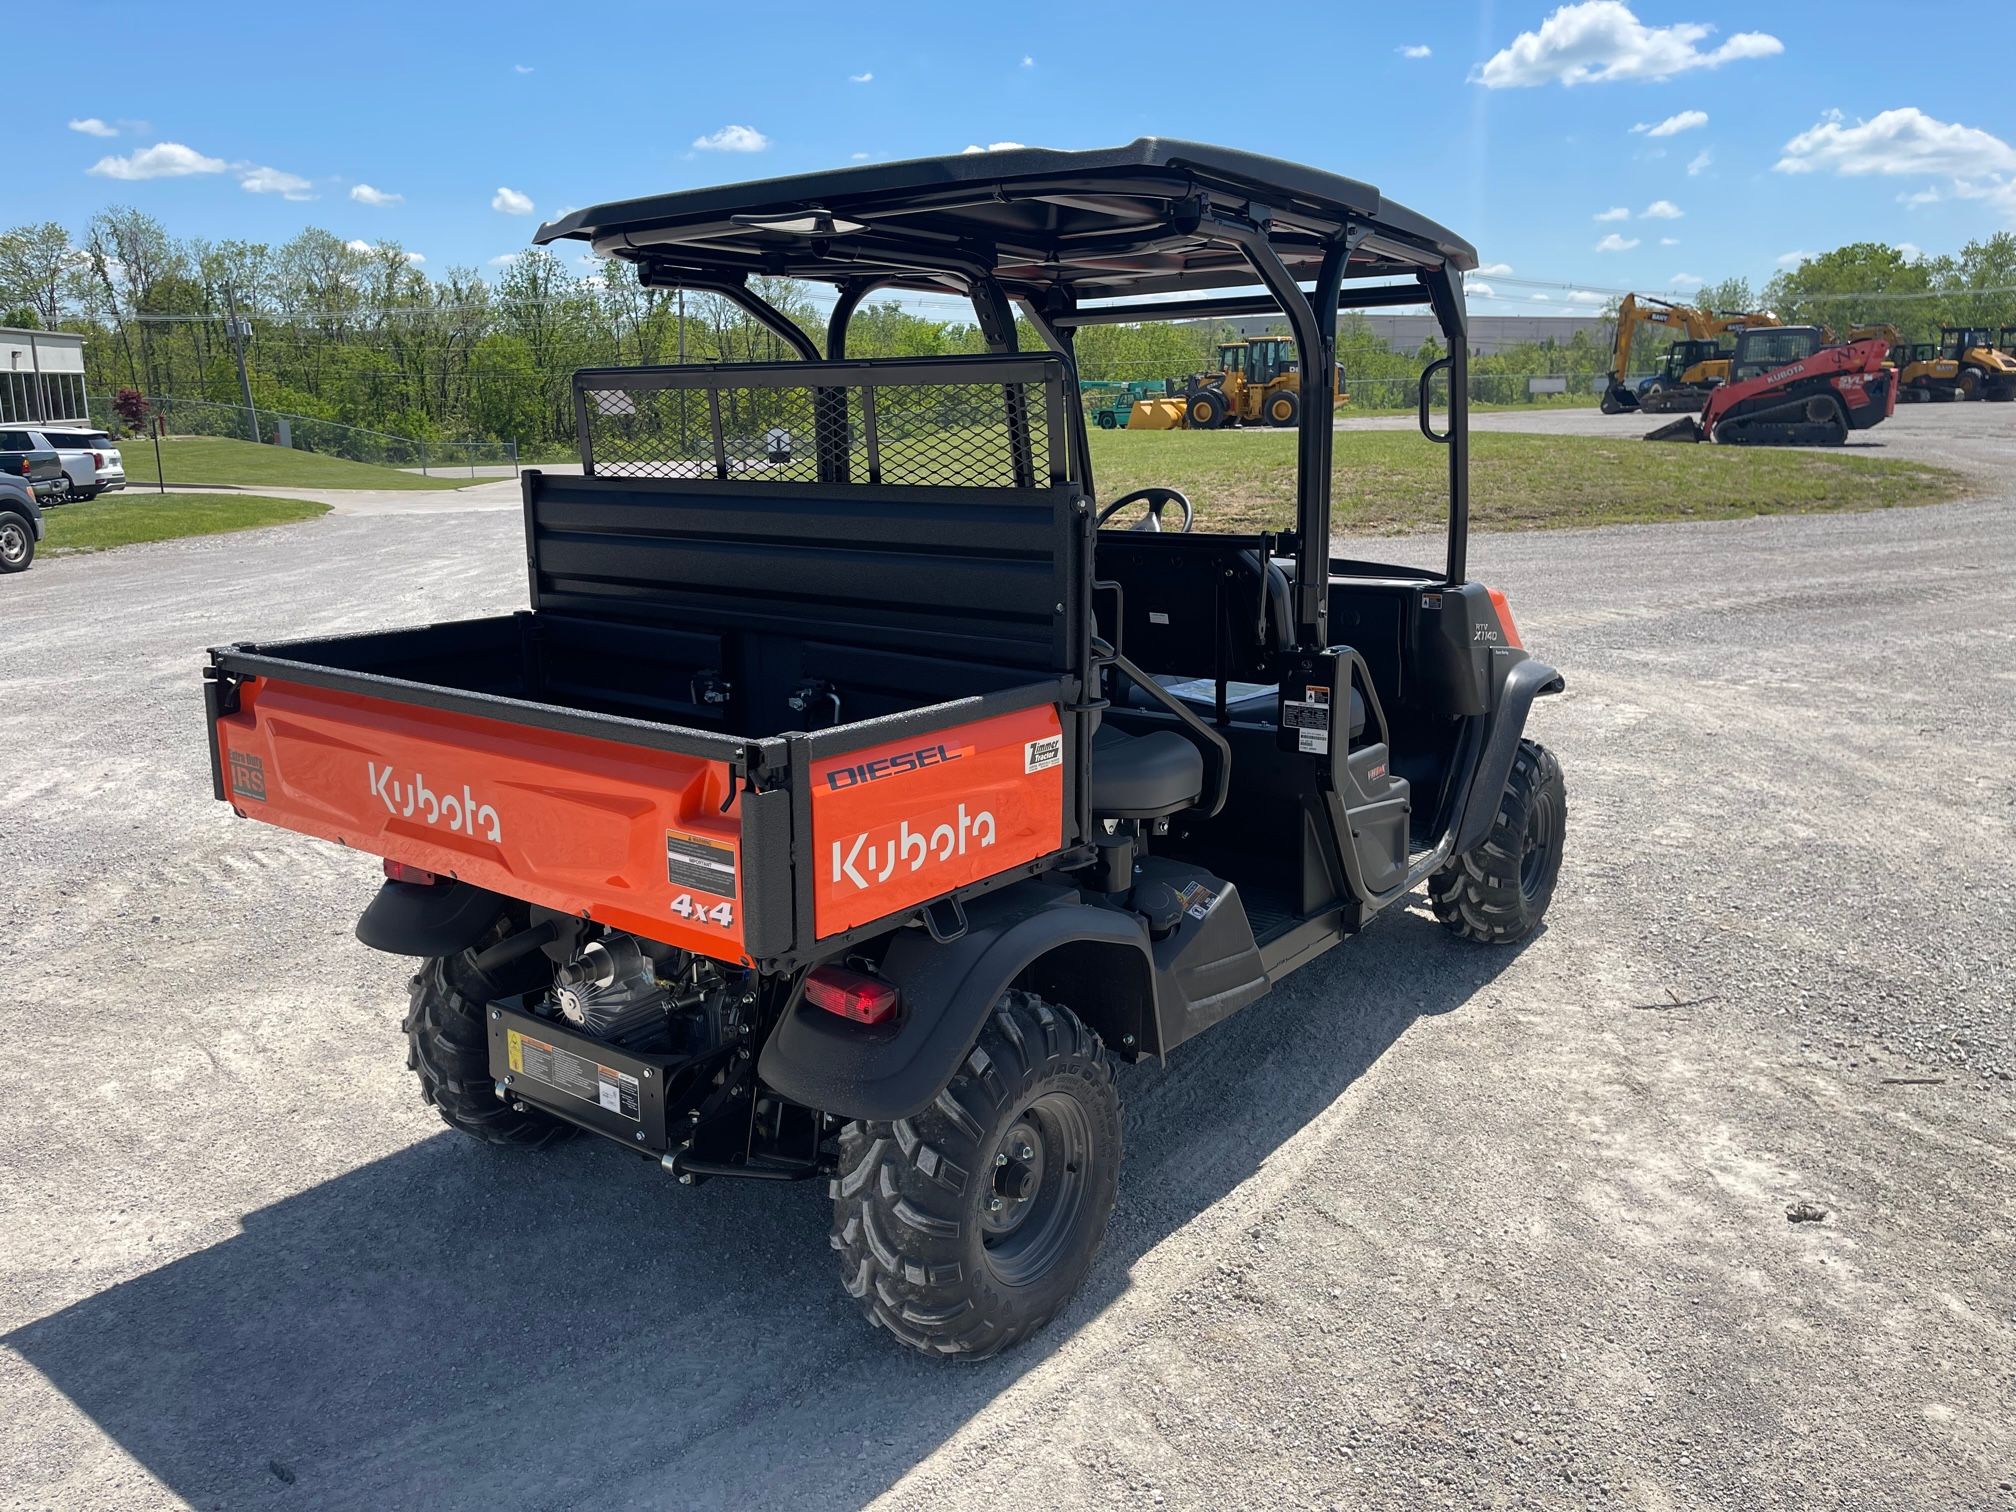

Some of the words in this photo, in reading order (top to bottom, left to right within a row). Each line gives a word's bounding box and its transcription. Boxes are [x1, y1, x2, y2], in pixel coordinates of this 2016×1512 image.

[1767, 364, 1805, 384] KUBOTA
[1473, 631, 1498, 641] X1140
[1475, 623, 1489, 631] RTV
[231, 765, 265, 793] IRS
[826, 744, 962, 791] DIESEL
[367, 761, 502, 843] Kubota
[832, 803, 996, 889] Kubota
[670, 894, 734, 928] 4x4
